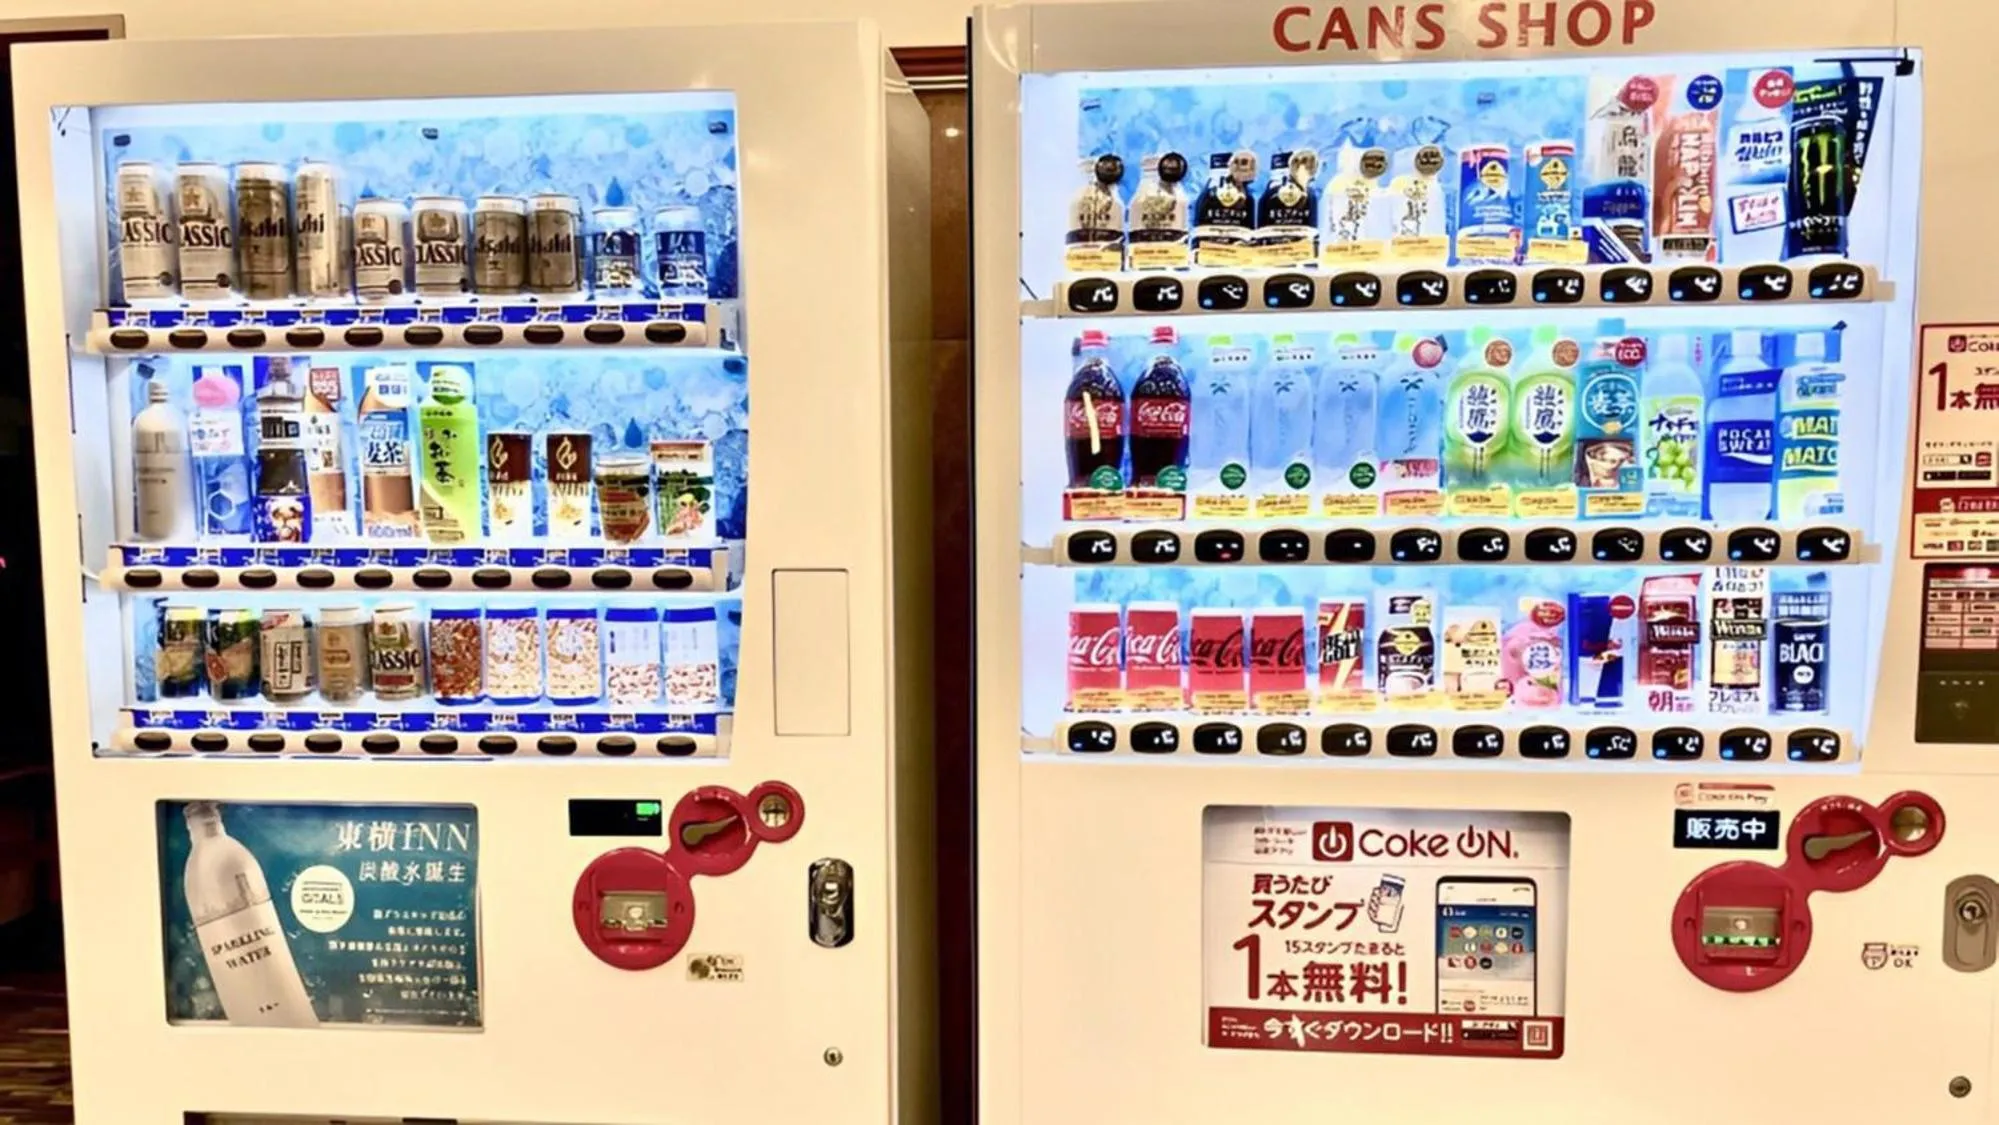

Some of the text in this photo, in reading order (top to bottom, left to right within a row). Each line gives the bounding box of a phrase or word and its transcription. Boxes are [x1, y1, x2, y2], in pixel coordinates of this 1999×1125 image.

[1273, 0, 1656, 52] CANS SHOP
[337, 820, 472, 853] 東横INN
[1359, 829, 1450, 860] Coke
[1686, 817, 1768, 841] 販売中
[358, 859, 467, 885] 炭酸水誕生
[1251, 873, 1334, 896] 買うたび
[1248, 898, 1365, 931] スタンプ
[1284, 940, 1406, 957] 15スタンプたまると
[1232, 933, 1408, 1006] 1本無料!
